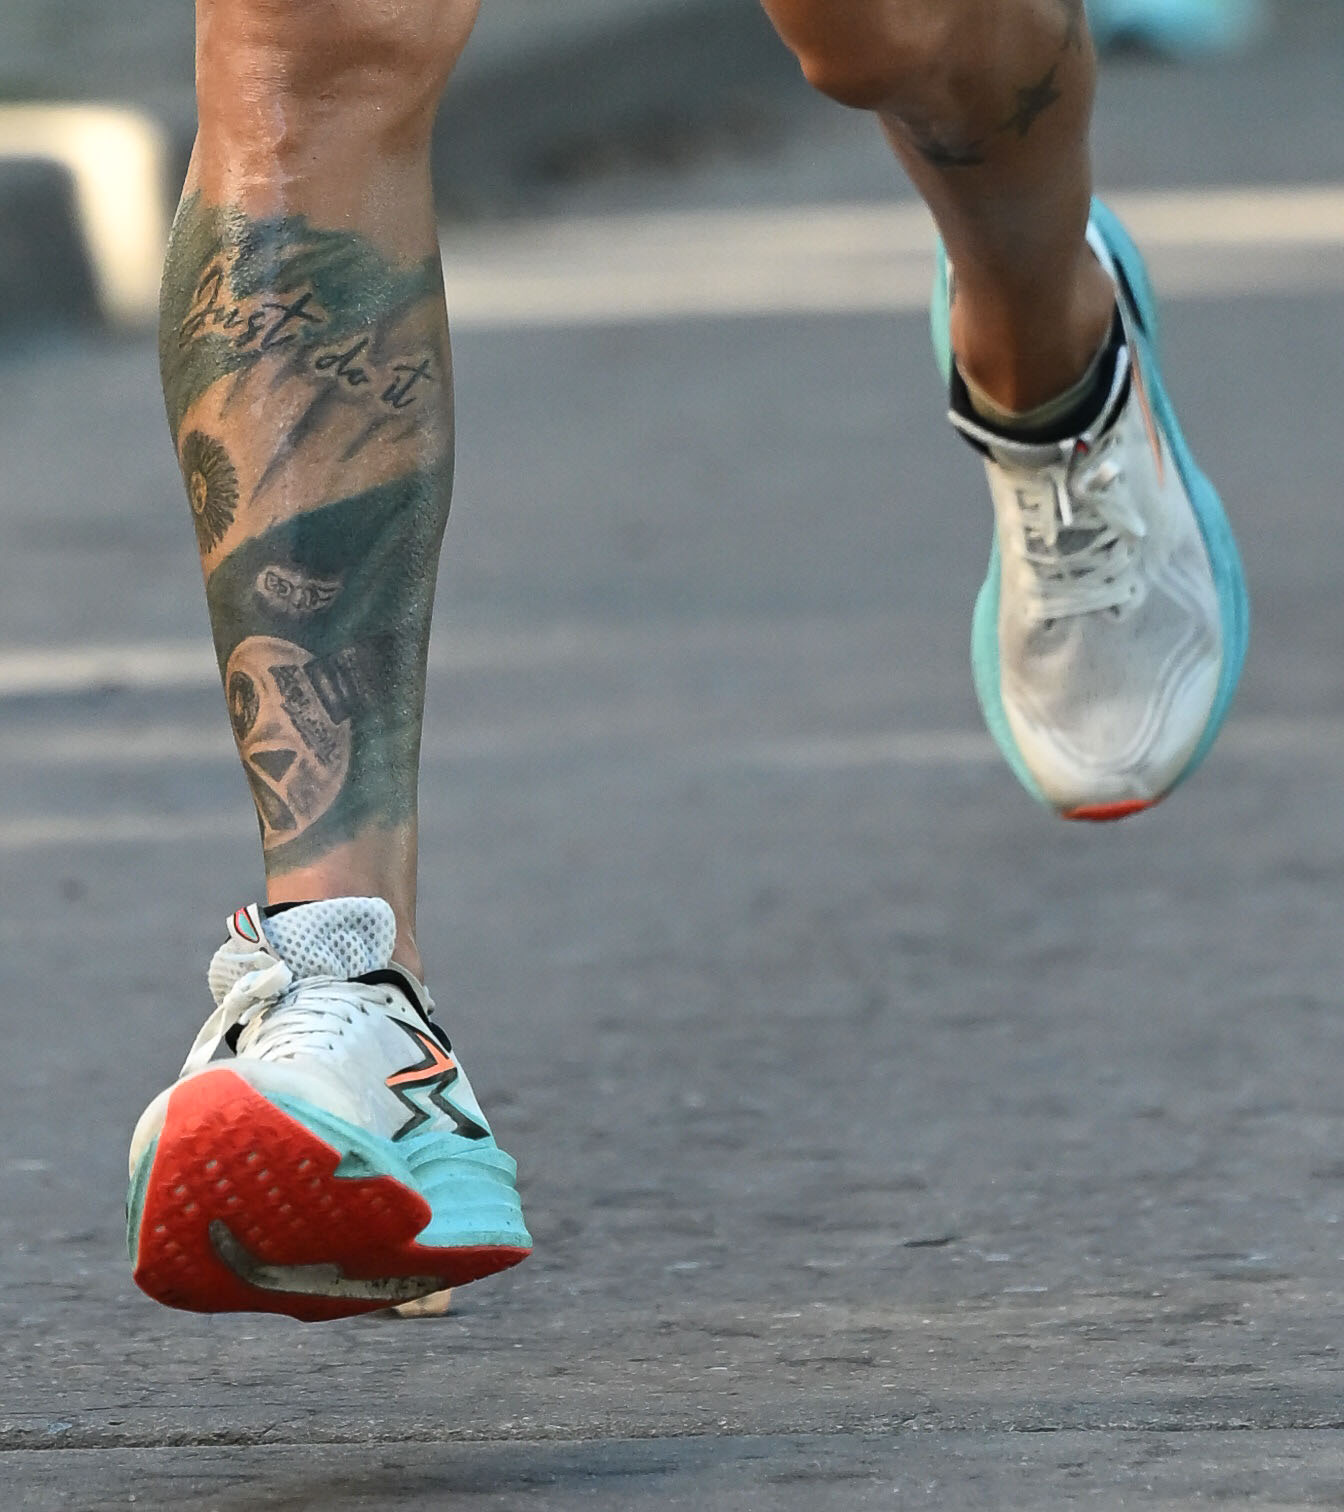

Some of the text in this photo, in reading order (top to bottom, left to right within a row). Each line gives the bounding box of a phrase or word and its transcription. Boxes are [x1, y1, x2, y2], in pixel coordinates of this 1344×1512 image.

[177, 265, 433, 410] Just do it
